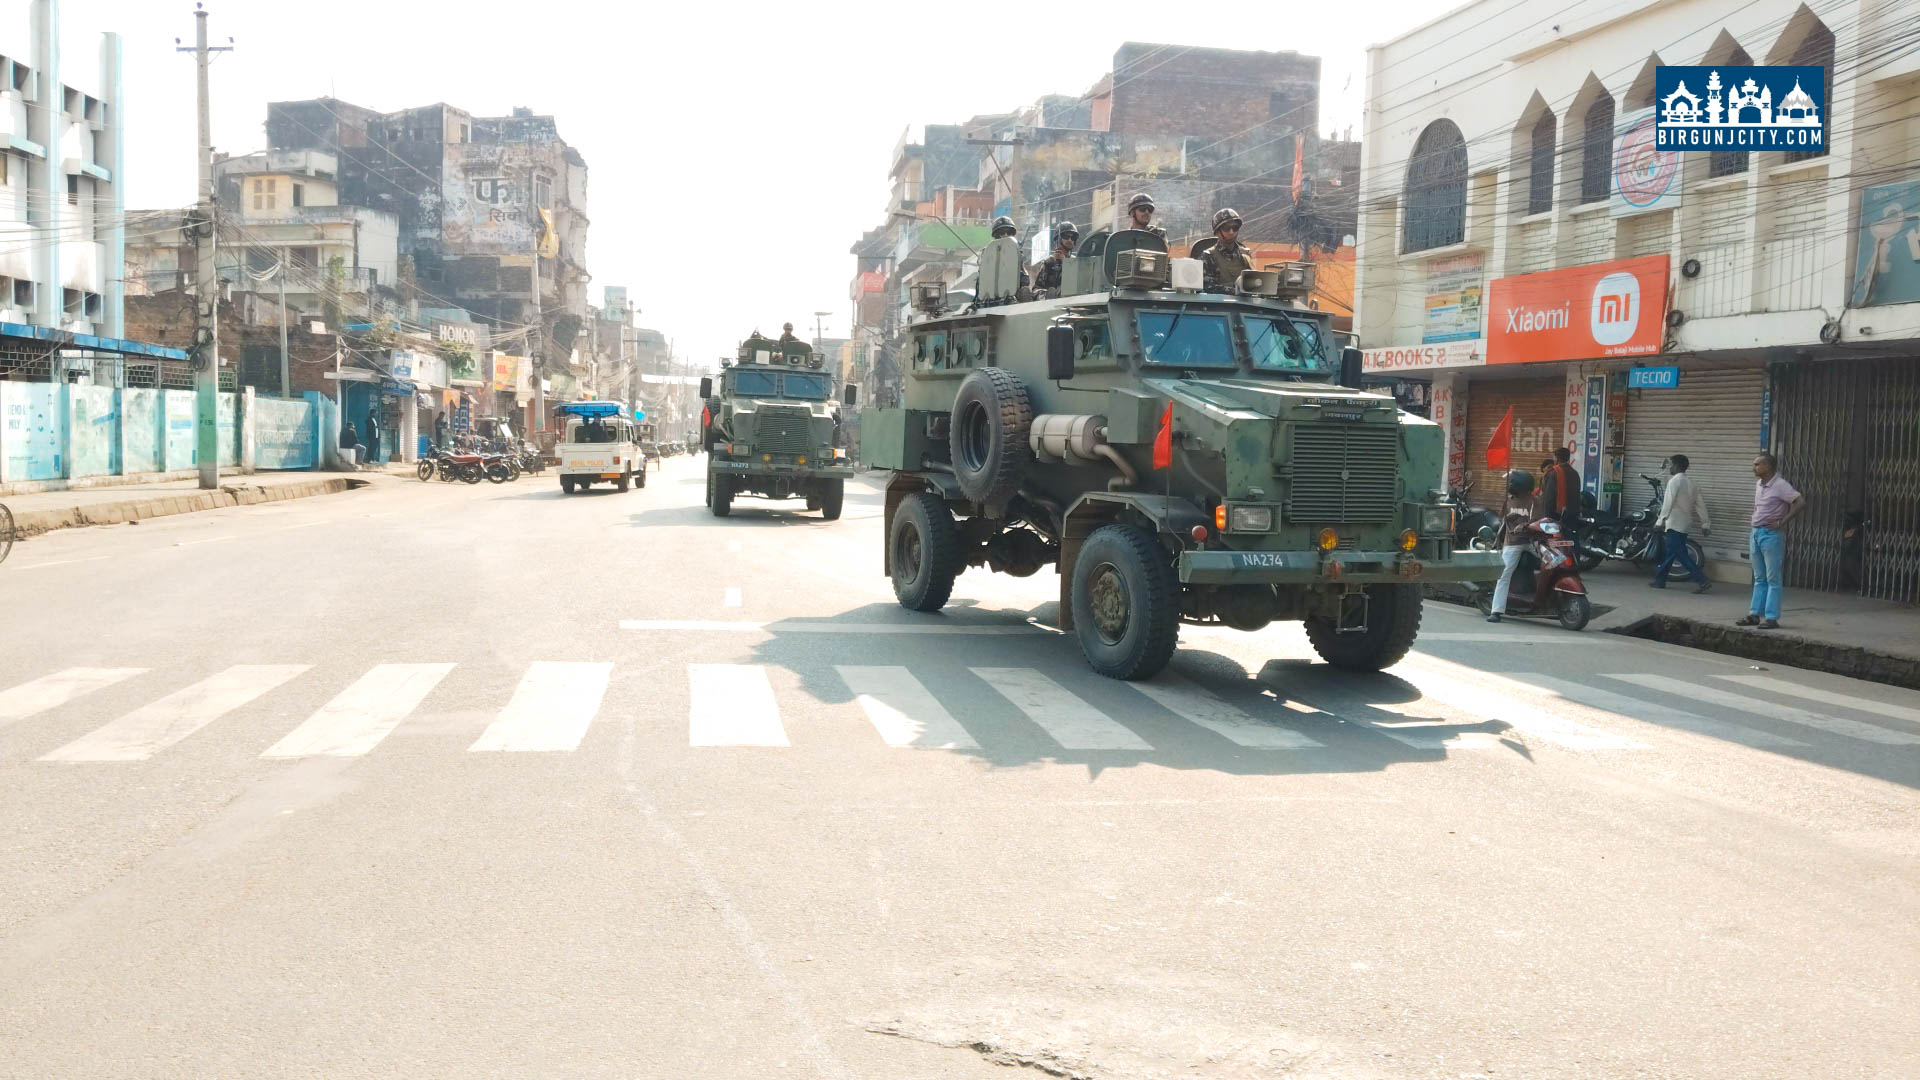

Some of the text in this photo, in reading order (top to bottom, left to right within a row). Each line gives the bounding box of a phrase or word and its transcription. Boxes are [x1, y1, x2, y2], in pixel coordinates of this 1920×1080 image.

[1505, 301, 1570, 334] Xiaomi
[439, 324, 476, 345] HONOR
[1384, 347, 1433, 367] BOOKS
[1635, 371, 1671, 384] TECNO
[1587, 394, 1601, 456] TECNO
[1242, 553, 1283, 567] NA274
